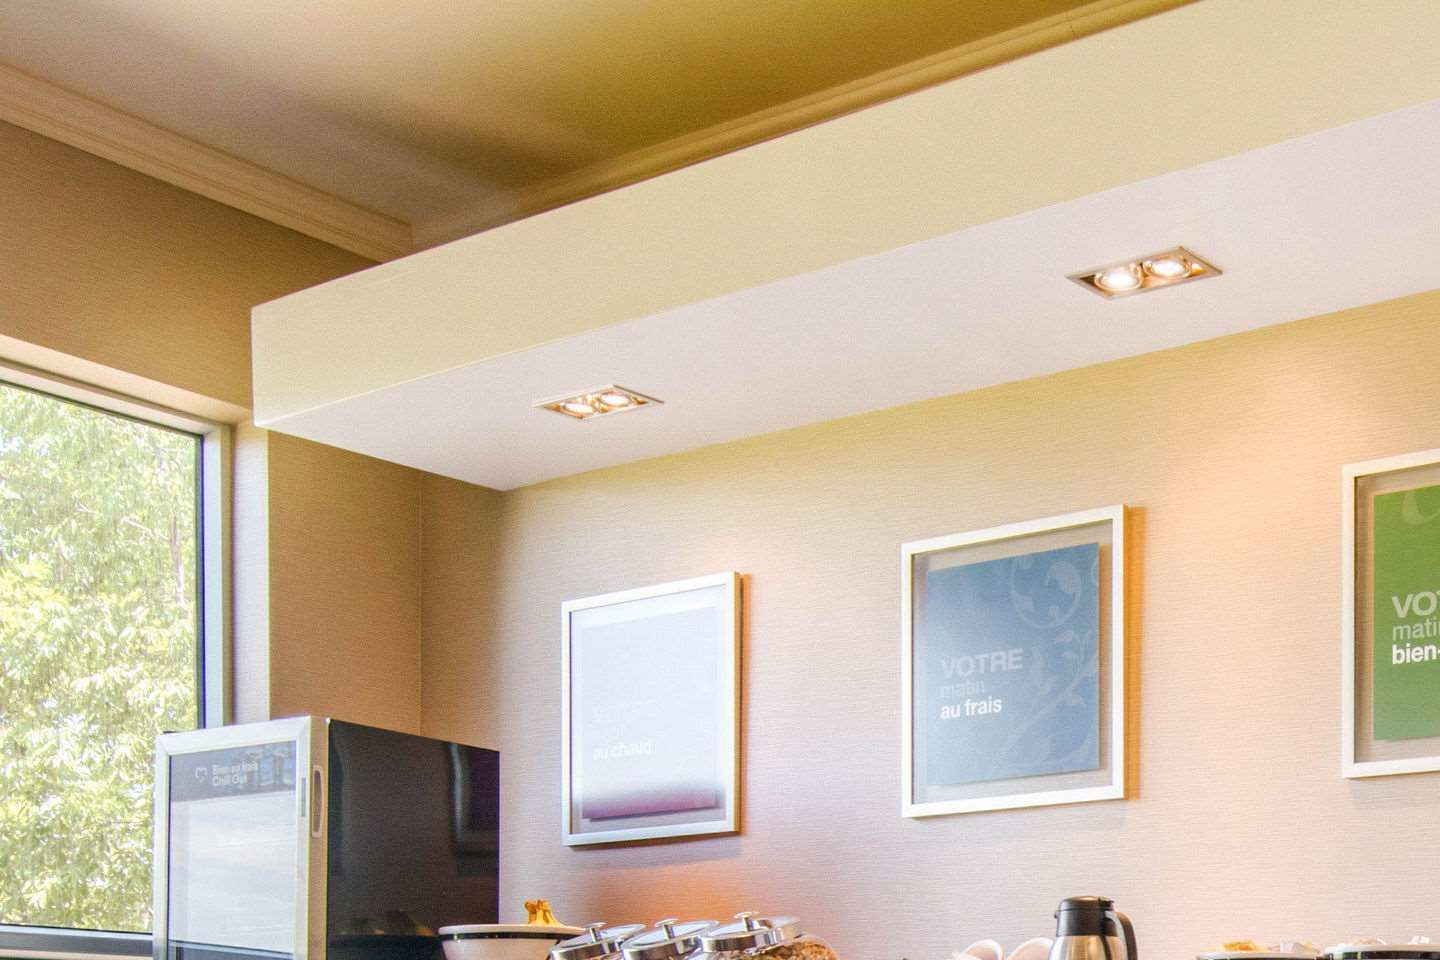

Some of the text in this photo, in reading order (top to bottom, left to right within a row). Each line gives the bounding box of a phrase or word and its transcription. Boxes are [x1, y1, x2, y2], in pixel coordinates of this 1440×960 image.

[940, 648, 1024, 679] VOTRE
[940, 696, 1003, 720] au frais
